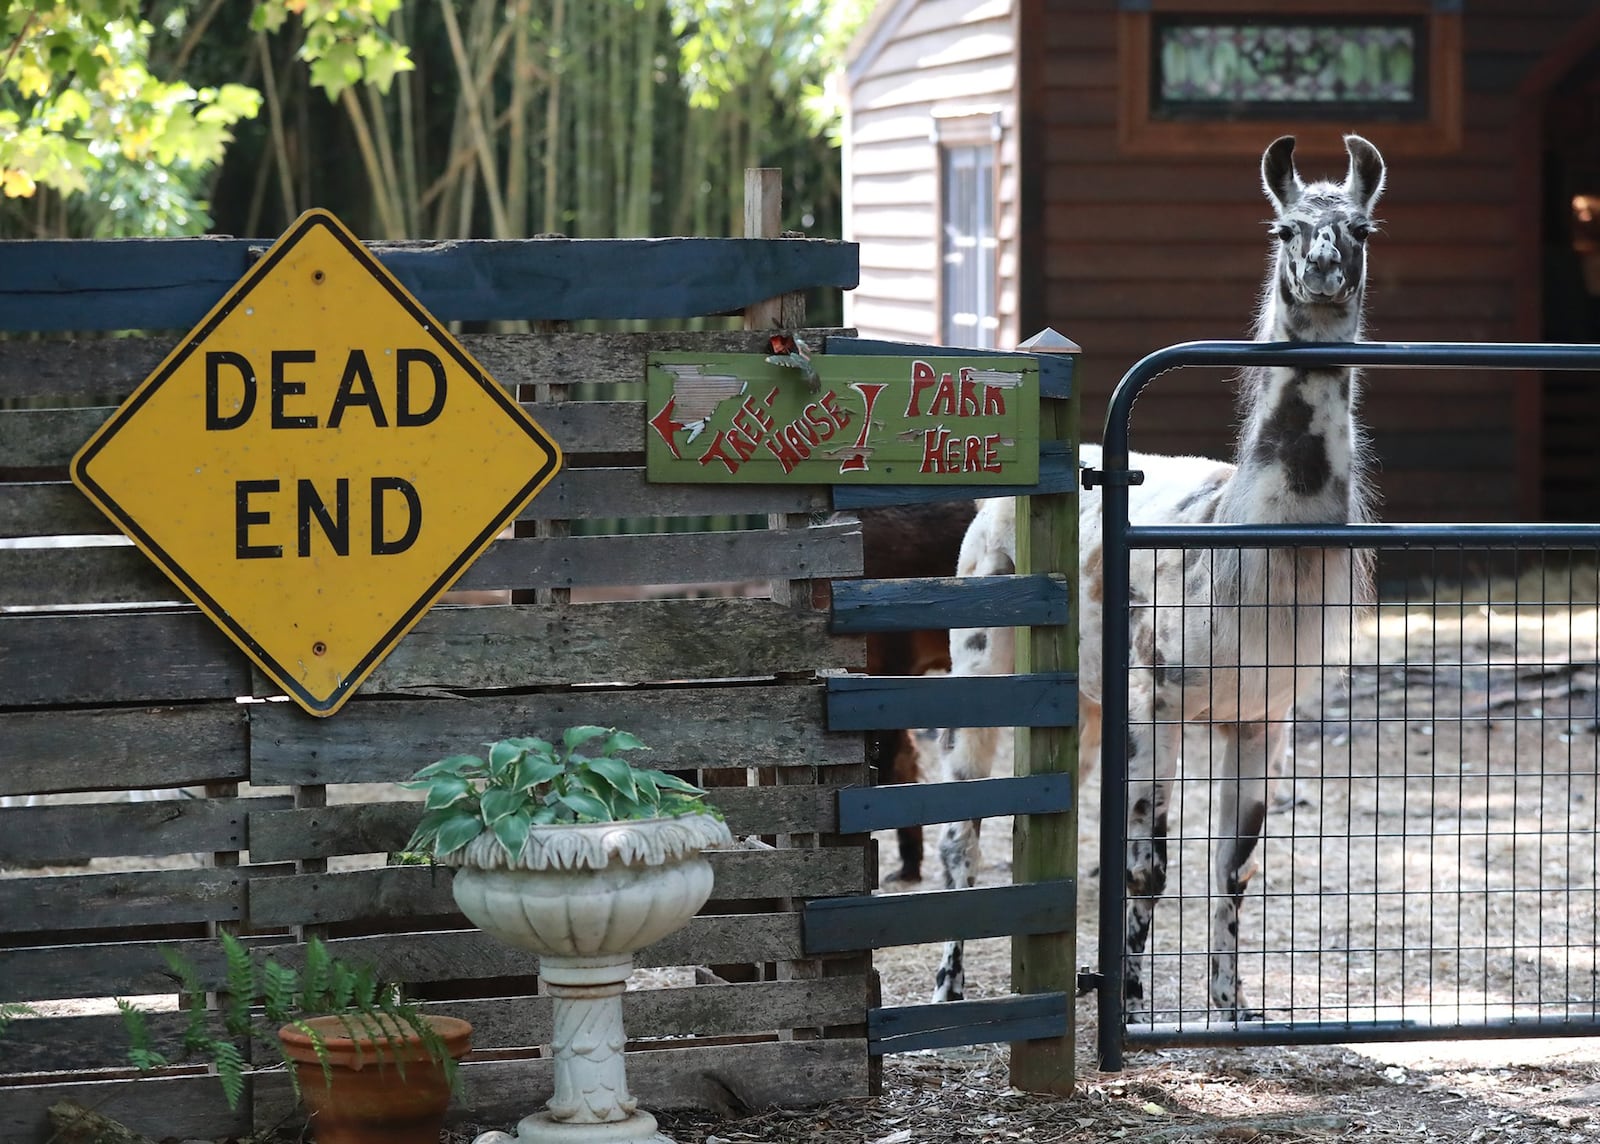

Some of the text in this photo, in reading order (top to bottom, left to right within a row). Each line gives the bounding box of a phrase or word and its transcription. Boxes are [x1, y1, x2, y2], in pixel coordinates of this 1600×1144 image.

[206, 349, 447, 431] DEAD
[904, 360, 1006, 417] PARK
[764, 389, 851, 474] HOUSE
[919, 427, 1002, 474] HERE
[236, 477, 422, 559] END
